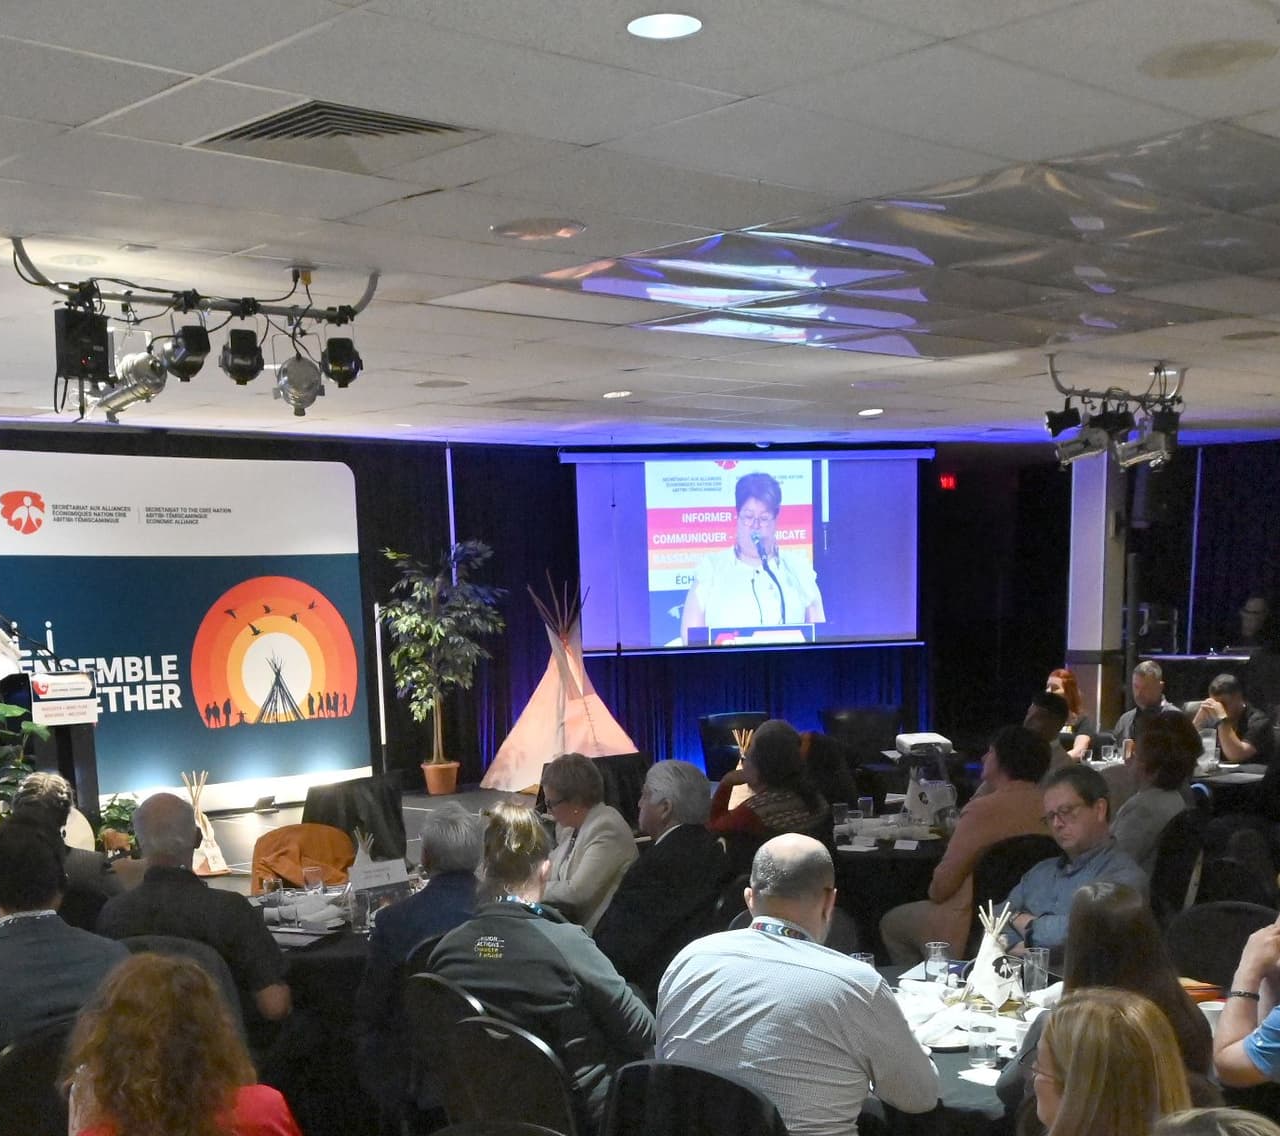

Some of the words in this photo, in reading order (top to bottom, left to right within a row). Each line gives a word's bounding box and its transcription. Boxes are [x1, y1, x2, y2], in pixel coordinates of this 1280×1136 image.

[682, 512, 732, 523] INFORMER
[653, 533, 727, 545] COMMUNIQUER
[775, 529, 807, 540] NICATE
[96, 683, 182, 713] THER
